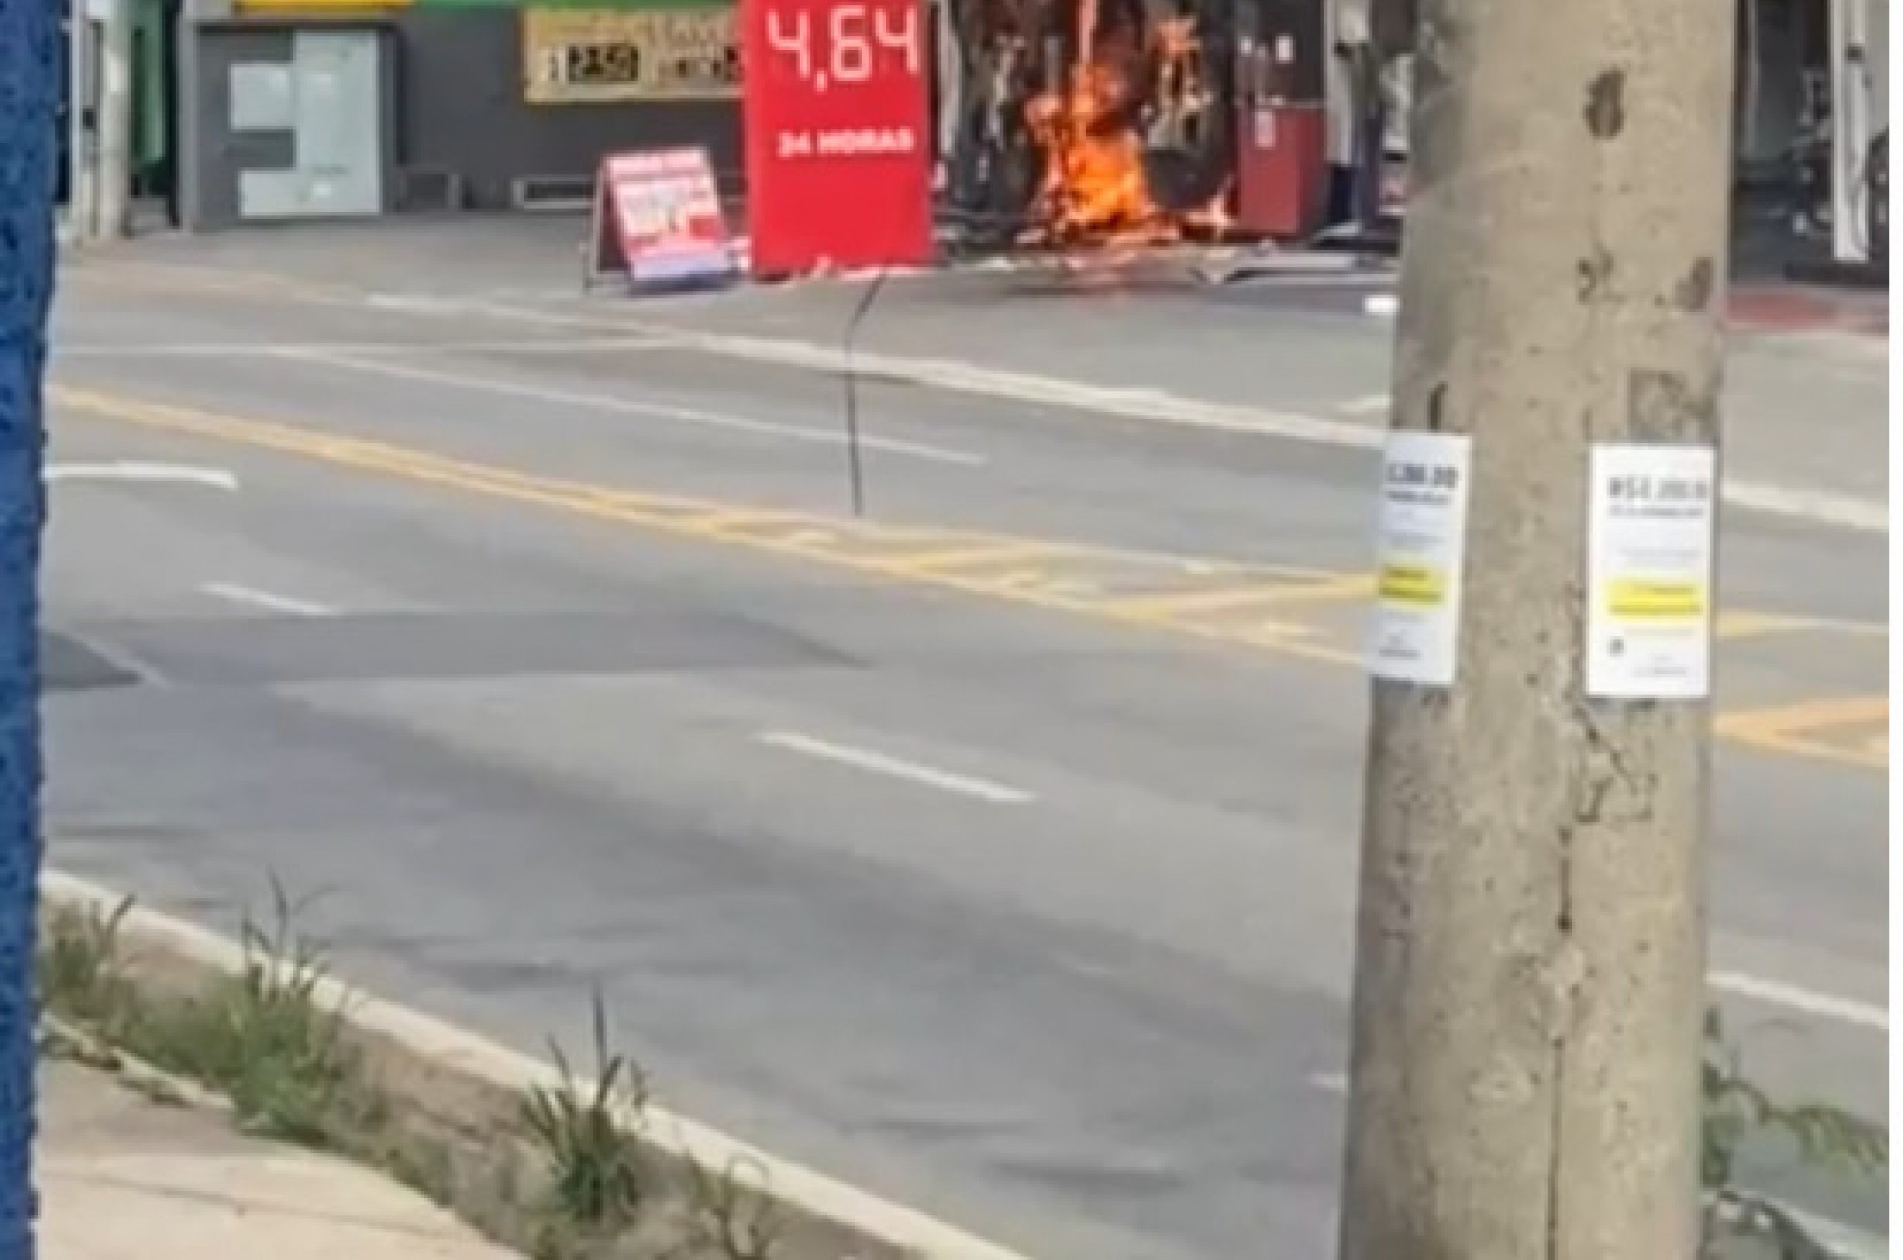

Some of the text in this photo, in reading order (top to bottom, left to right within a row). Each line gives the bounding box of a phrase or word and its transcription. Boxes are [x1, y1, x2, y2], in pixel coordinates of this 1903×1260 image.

[764, 4, 920, 92] 4,64
[777, 125, 914, 158] 24 HORAS
